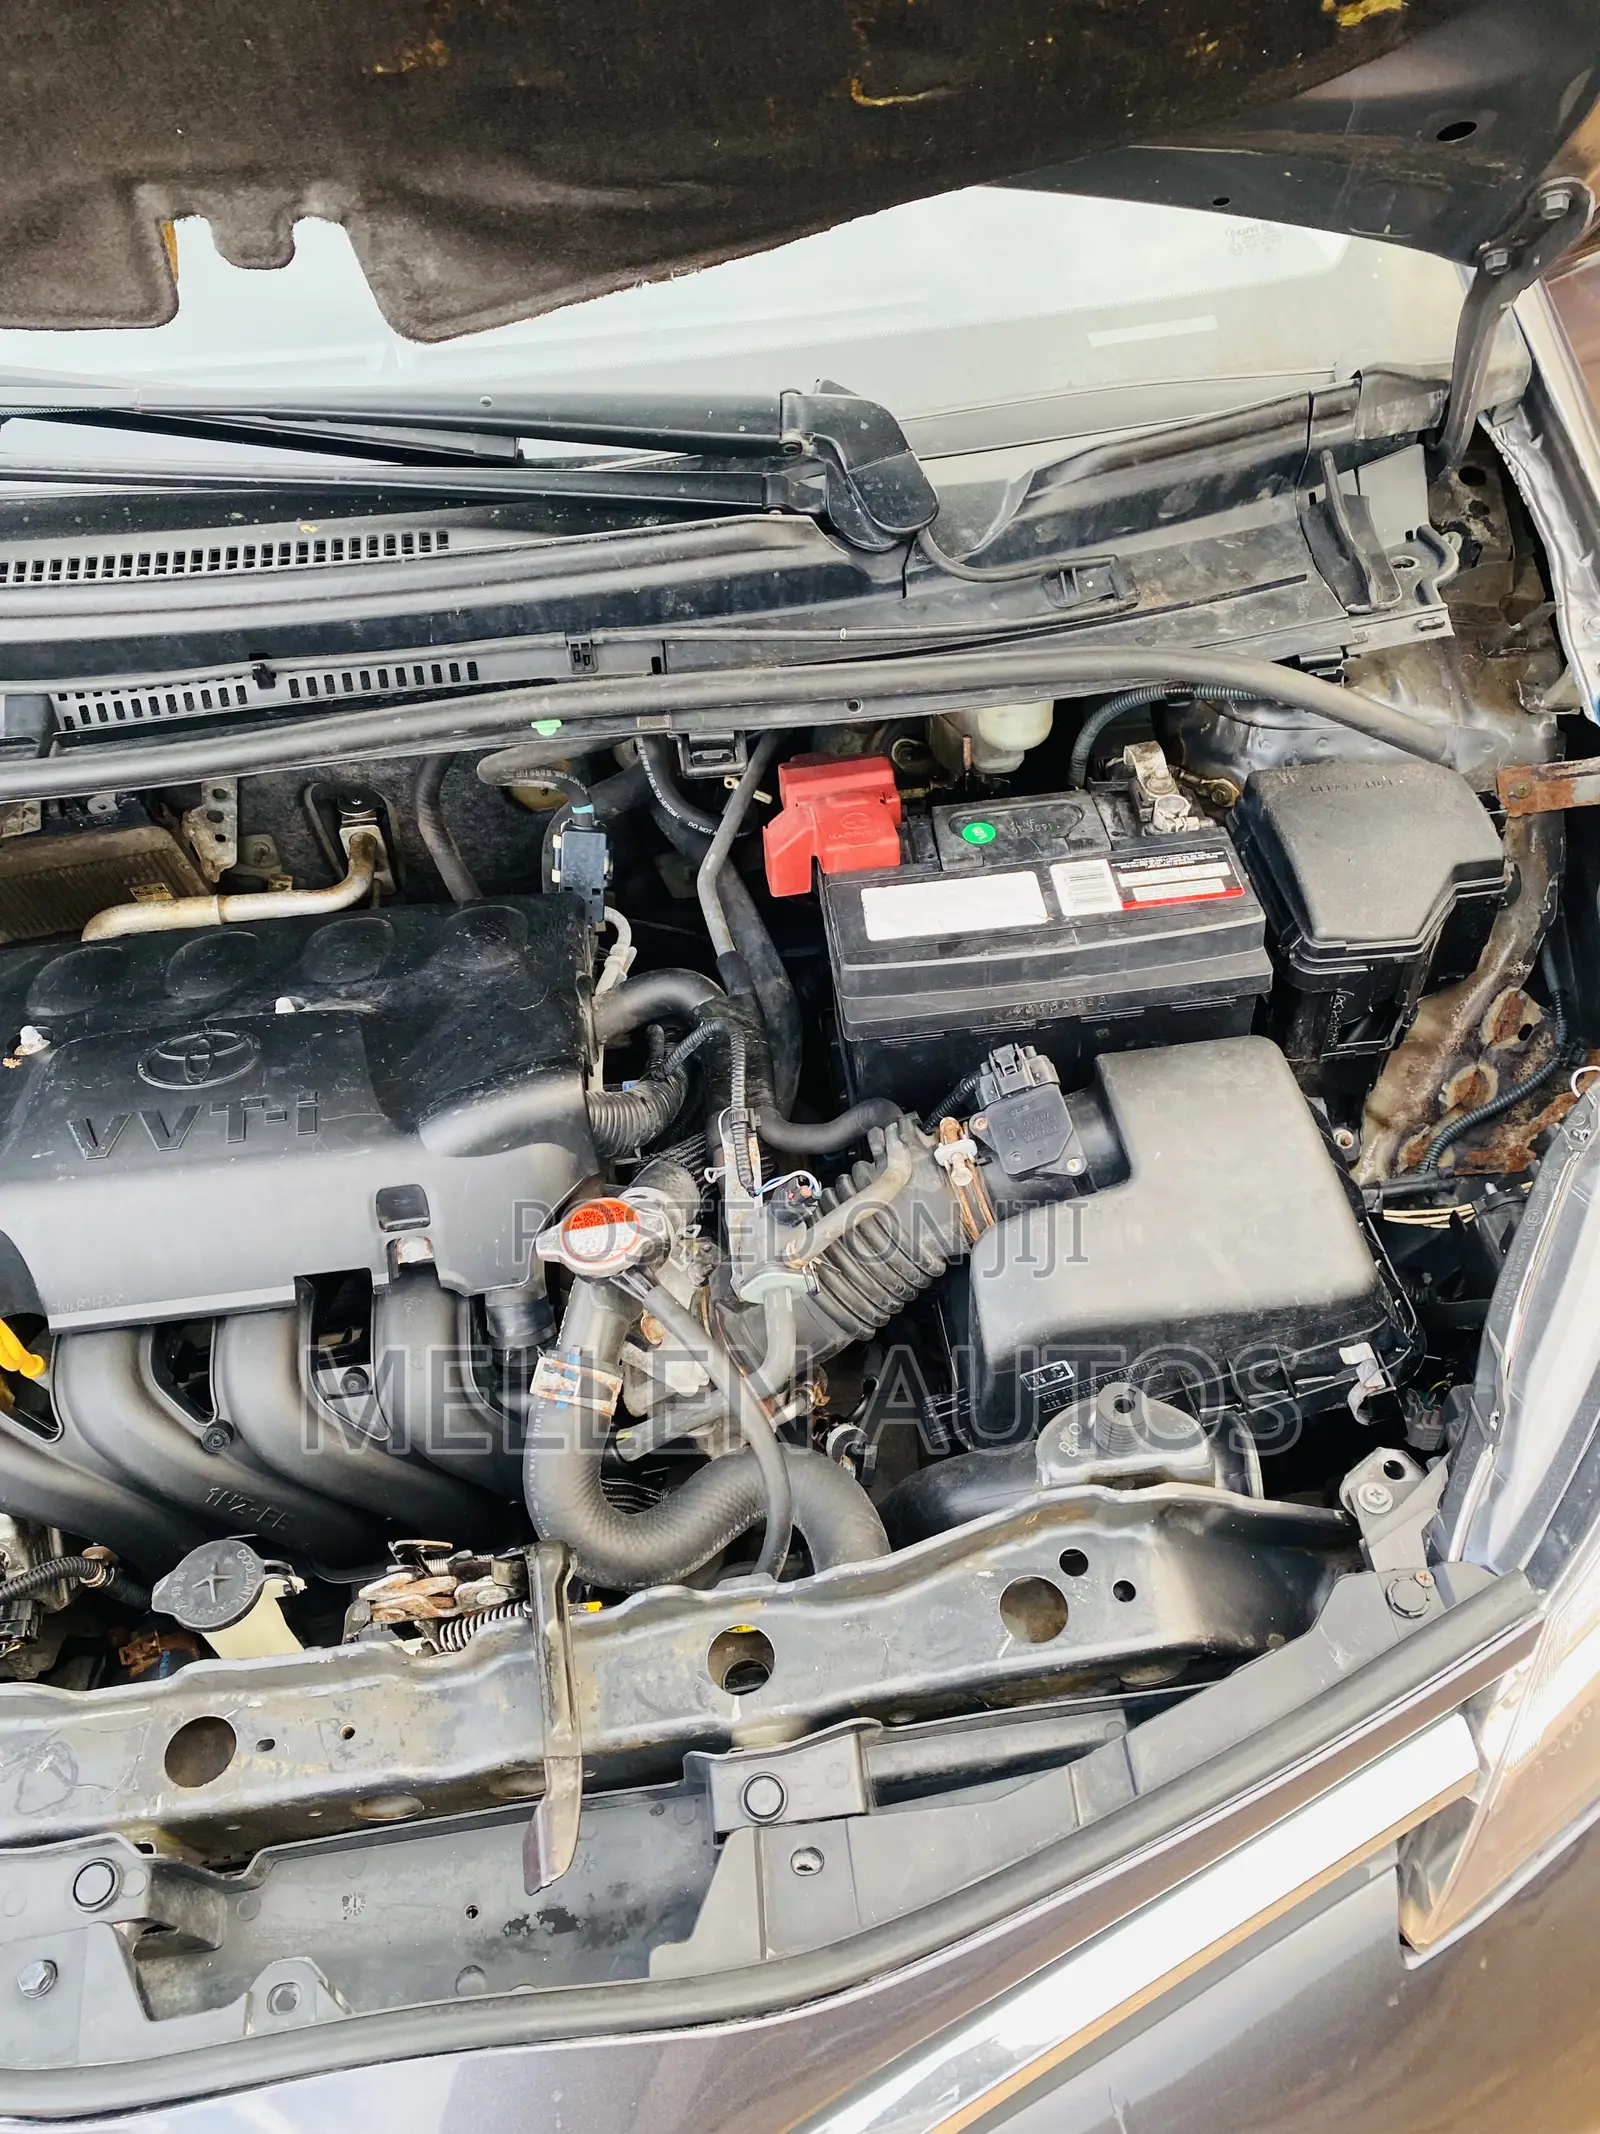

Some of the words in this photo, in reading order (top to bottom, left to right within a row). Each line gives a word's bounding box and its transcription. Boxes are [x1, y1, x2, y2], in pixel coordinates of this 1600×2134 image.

[687, 821, 699, 831] DO
[699, 825, 713, 836] NOT
[236, 1549, 257, 1602] COOLANT
